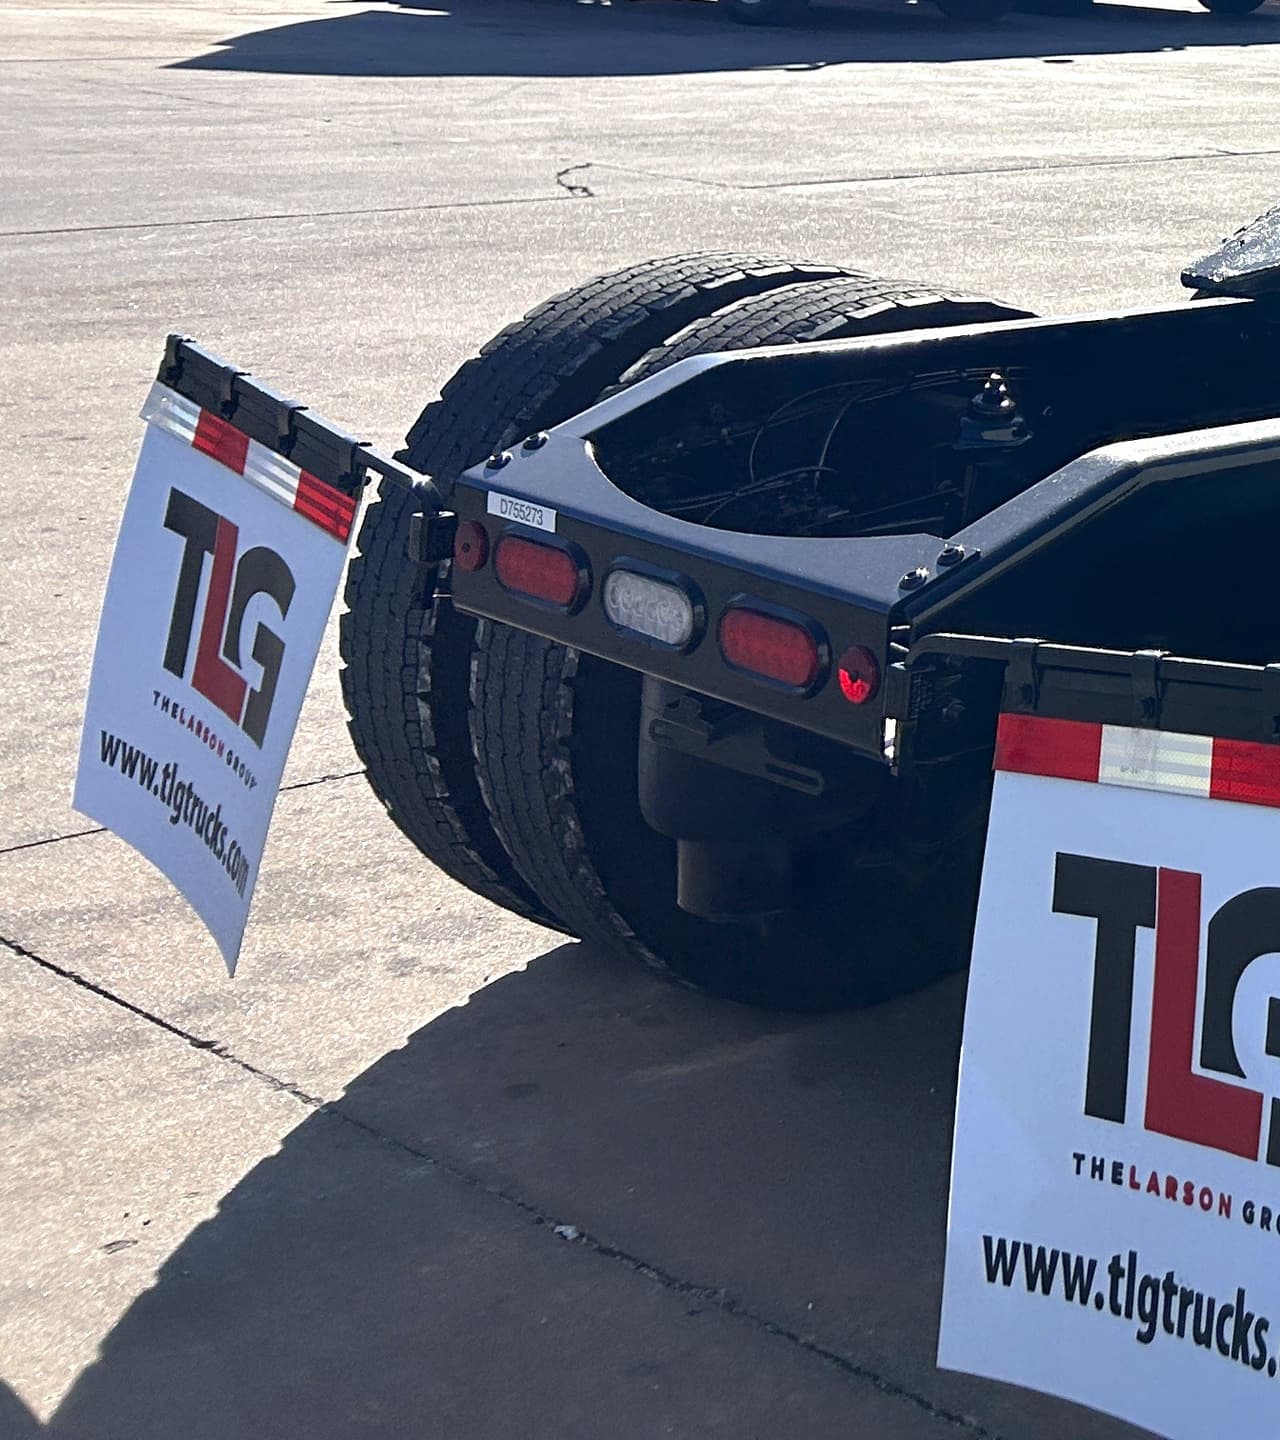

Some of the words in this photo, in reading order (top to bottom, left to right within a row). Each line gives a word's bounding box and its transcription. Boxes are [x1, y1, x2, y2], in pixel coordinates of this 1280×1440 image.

[500, 498, 544, 526] D755273
[162, 485, 296, 750] TLG
[100, 729, 250, 900] www.tlgtrucks.com
